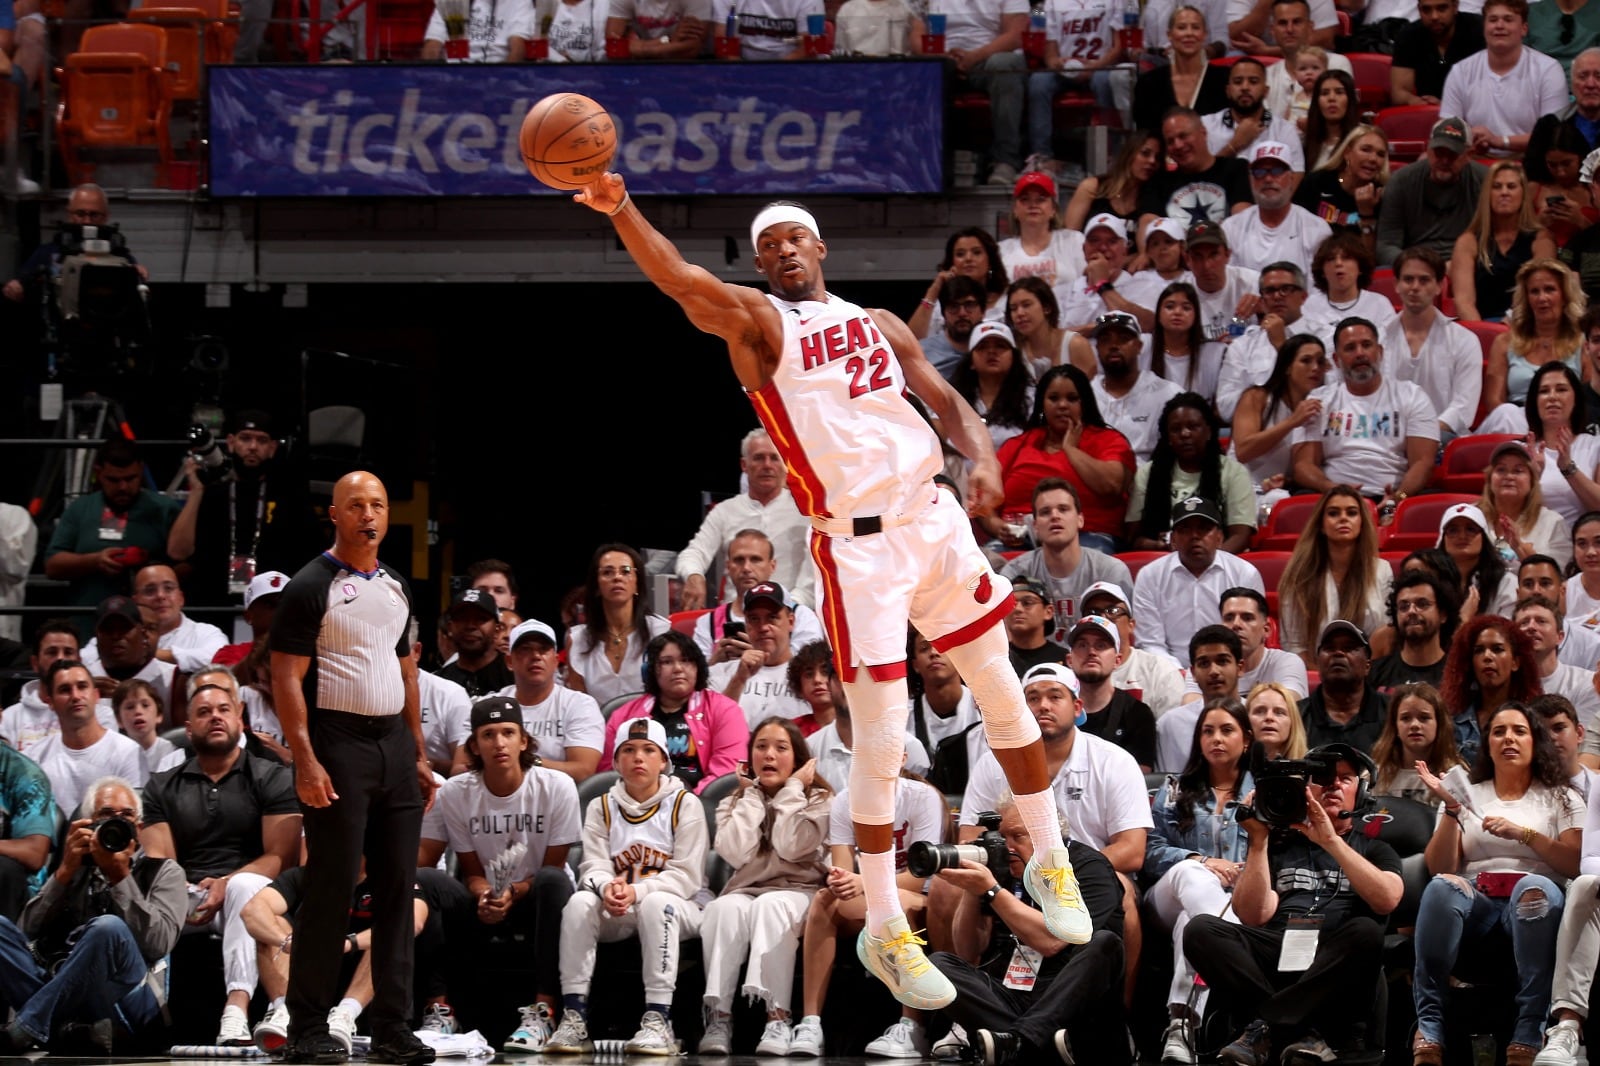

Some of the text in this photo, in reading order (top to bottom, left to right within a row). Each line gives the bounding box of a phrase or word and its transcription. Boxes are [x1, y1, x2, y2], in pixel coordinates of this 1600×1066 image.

[1071, 37, 1103, 60] 22
[289, 88, 862, 175] ticketaster
[845, 347, 893, 400] 22
[1323, 411, 1399, 438] MIAMI
[744, 682, 794, 699] ULTUR
[523, 719, 565, 738] TURE
[469, 813, 545, 835] CULTURE
